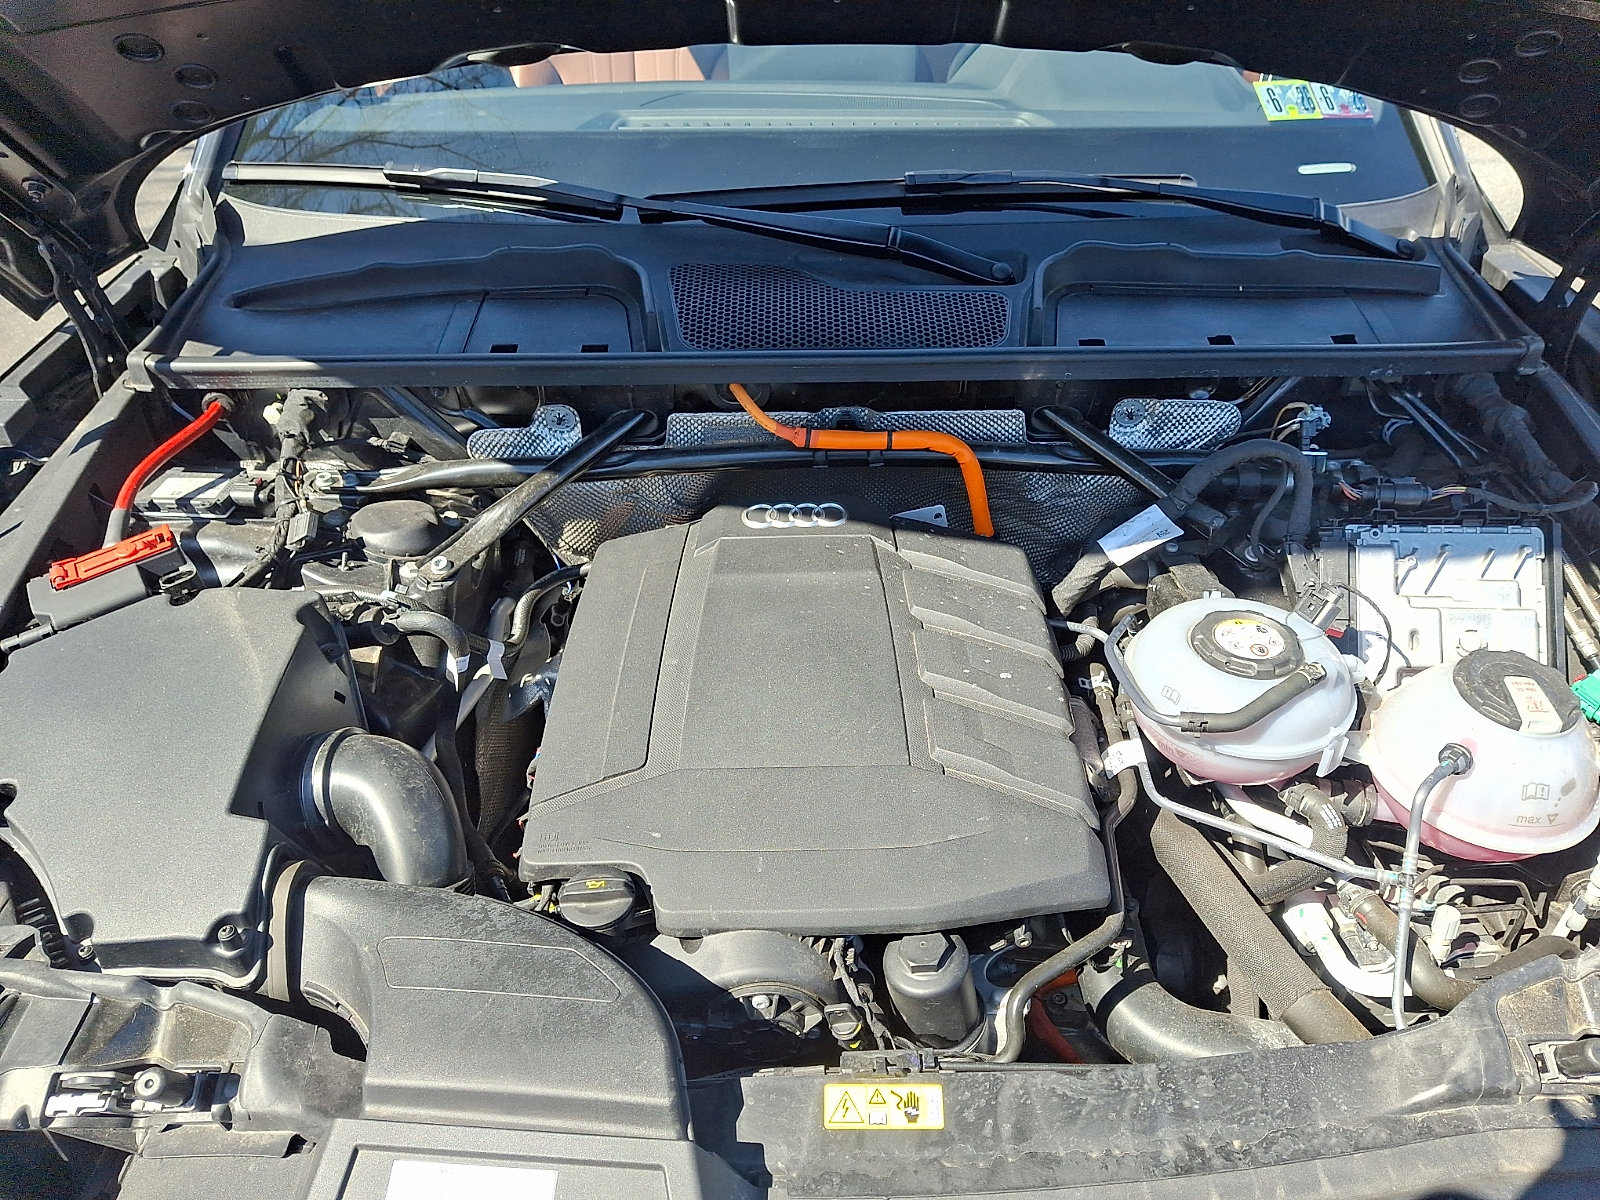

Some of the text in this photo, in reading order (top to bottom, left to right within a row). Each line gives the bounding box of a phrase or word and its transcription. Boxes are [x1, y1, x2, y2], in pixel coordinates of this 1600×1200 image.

[1266, 87, 1283, 113] 6
[1319, 86, 1335, 111] 6
[1516, 815, 1542, 825] max
